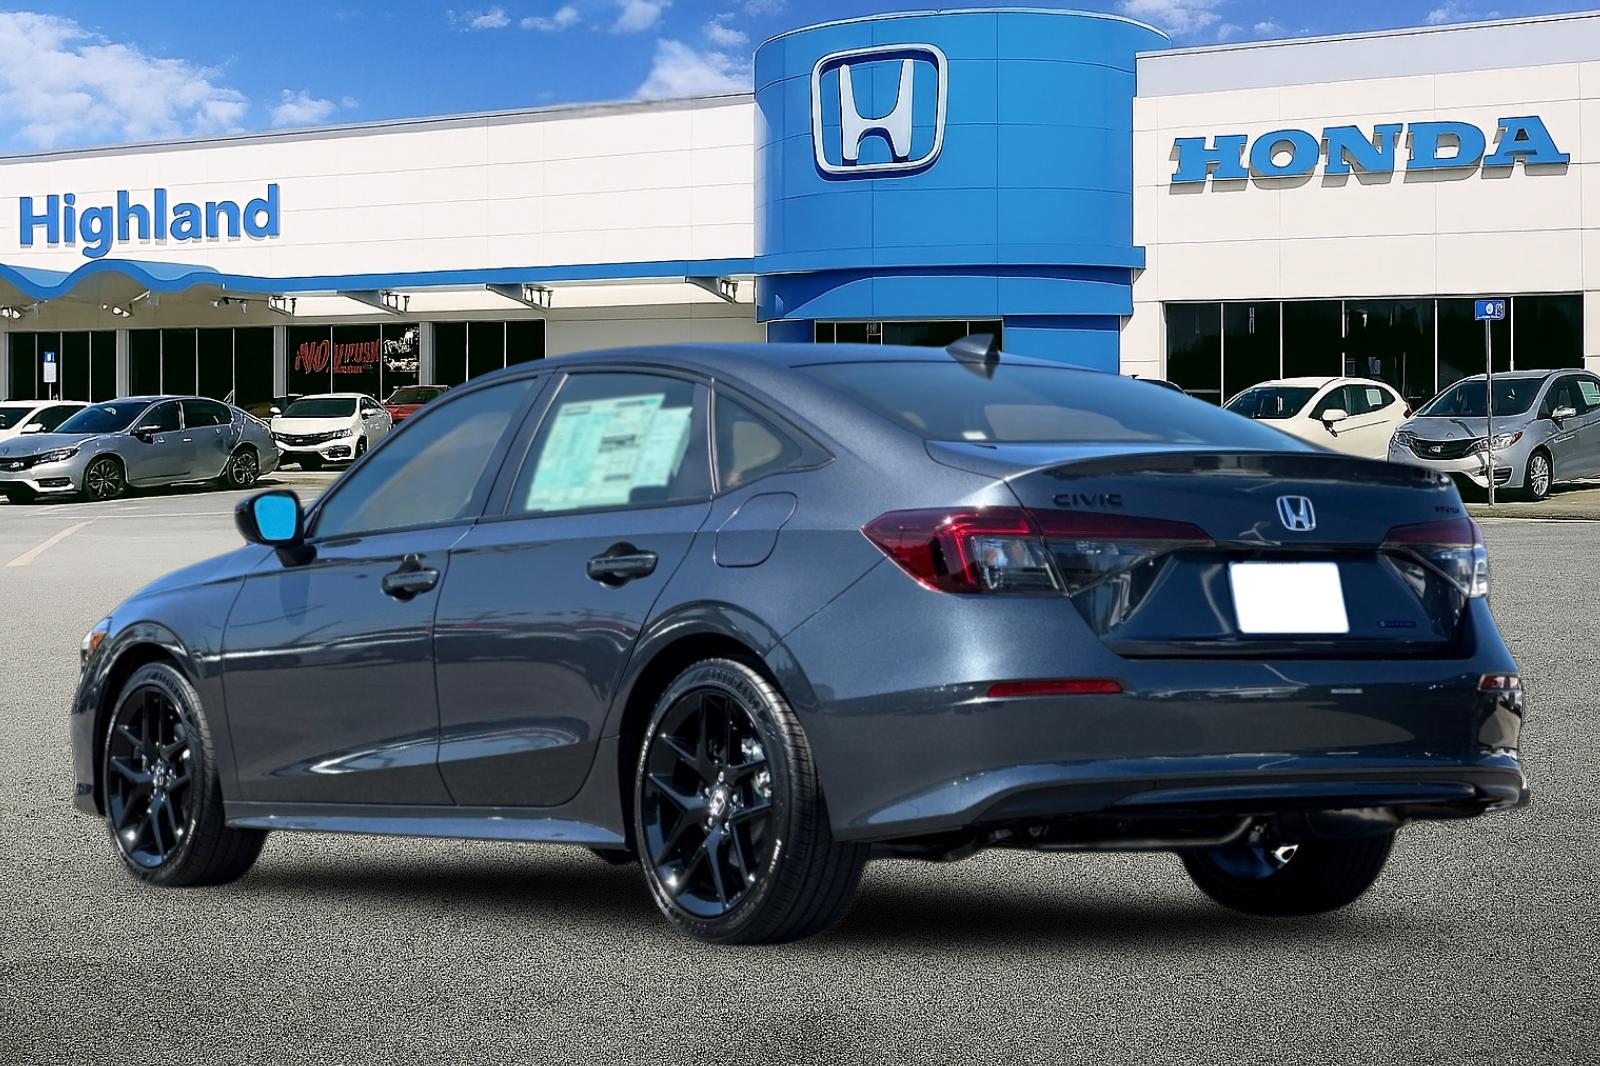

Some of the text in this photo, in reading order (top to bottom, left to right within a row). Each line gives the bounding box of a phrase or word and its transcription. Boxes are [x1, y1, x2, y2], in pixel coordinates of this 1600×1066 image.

[1171, 115, 1571, 183] HONDA
[19, 183, 280, 258] Highland
[1052, 493, 1123, 506] CIVIC
